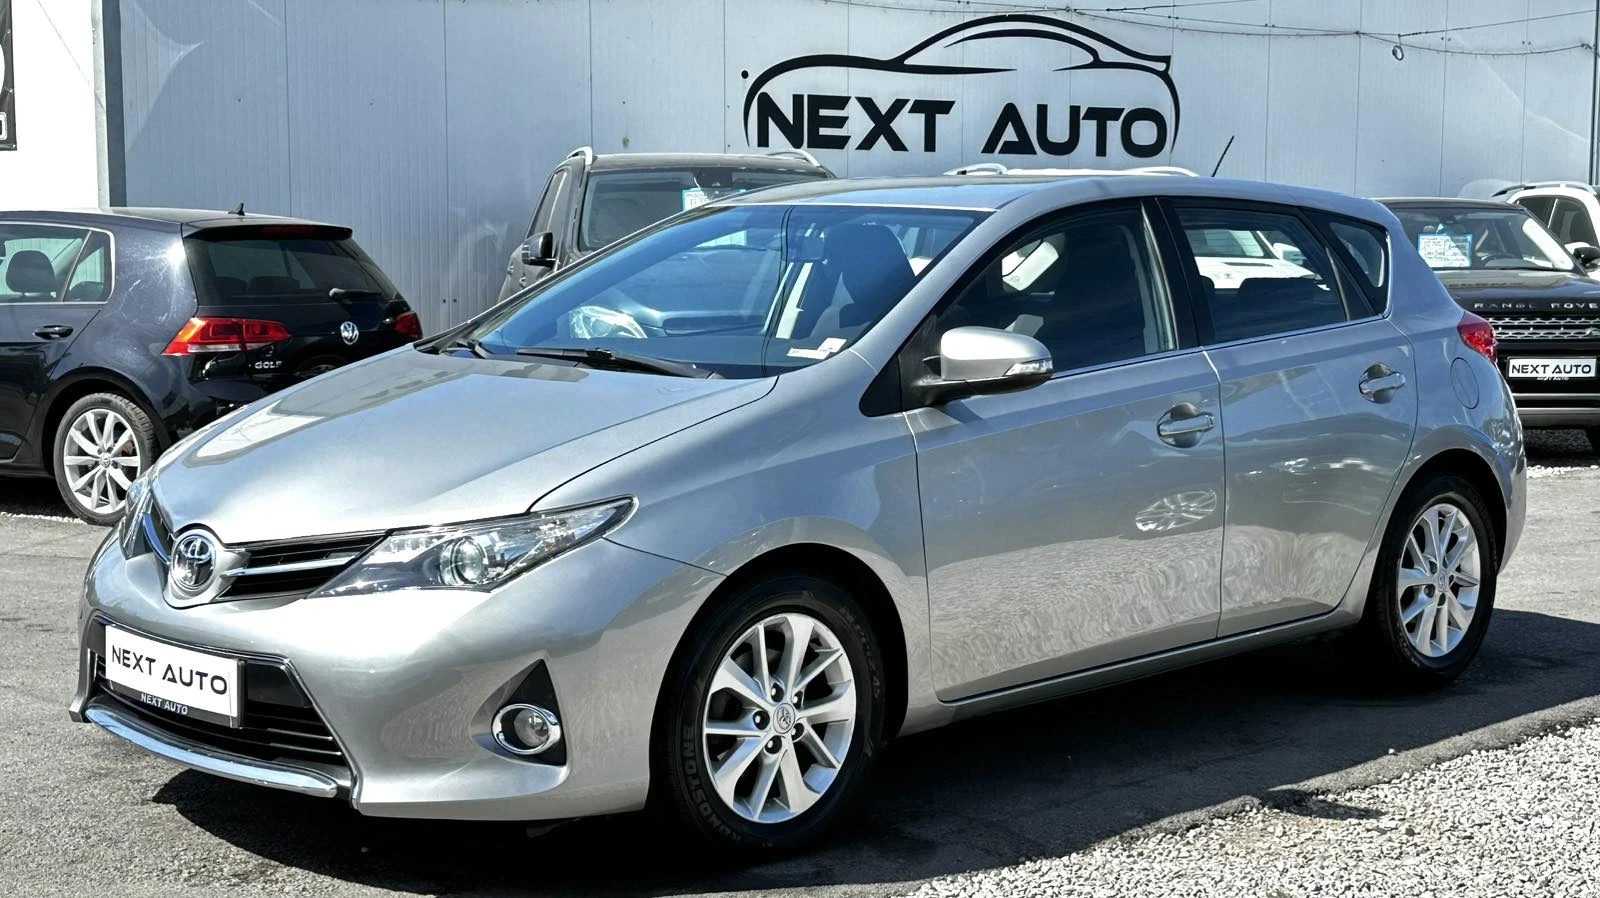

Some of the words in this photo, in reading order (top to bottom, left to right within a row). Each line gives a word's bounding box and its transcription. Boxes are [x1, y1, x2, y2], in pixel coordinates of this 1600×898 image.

[757, 91, 956, 153] NEXT
[981, 102, 1168, 158] AUTO
[254, 361, 282, 369] GOLF
[1511, 364, 1550, 374] NEXT
[1552, 364, 1592, 374] AUTO
[112, 644, 156, 676] NEXT
[162, 663, 228, 695] AUTO
[141, 693, 163, 708] NEXT
[164, 701, 189, 715] AUTO
